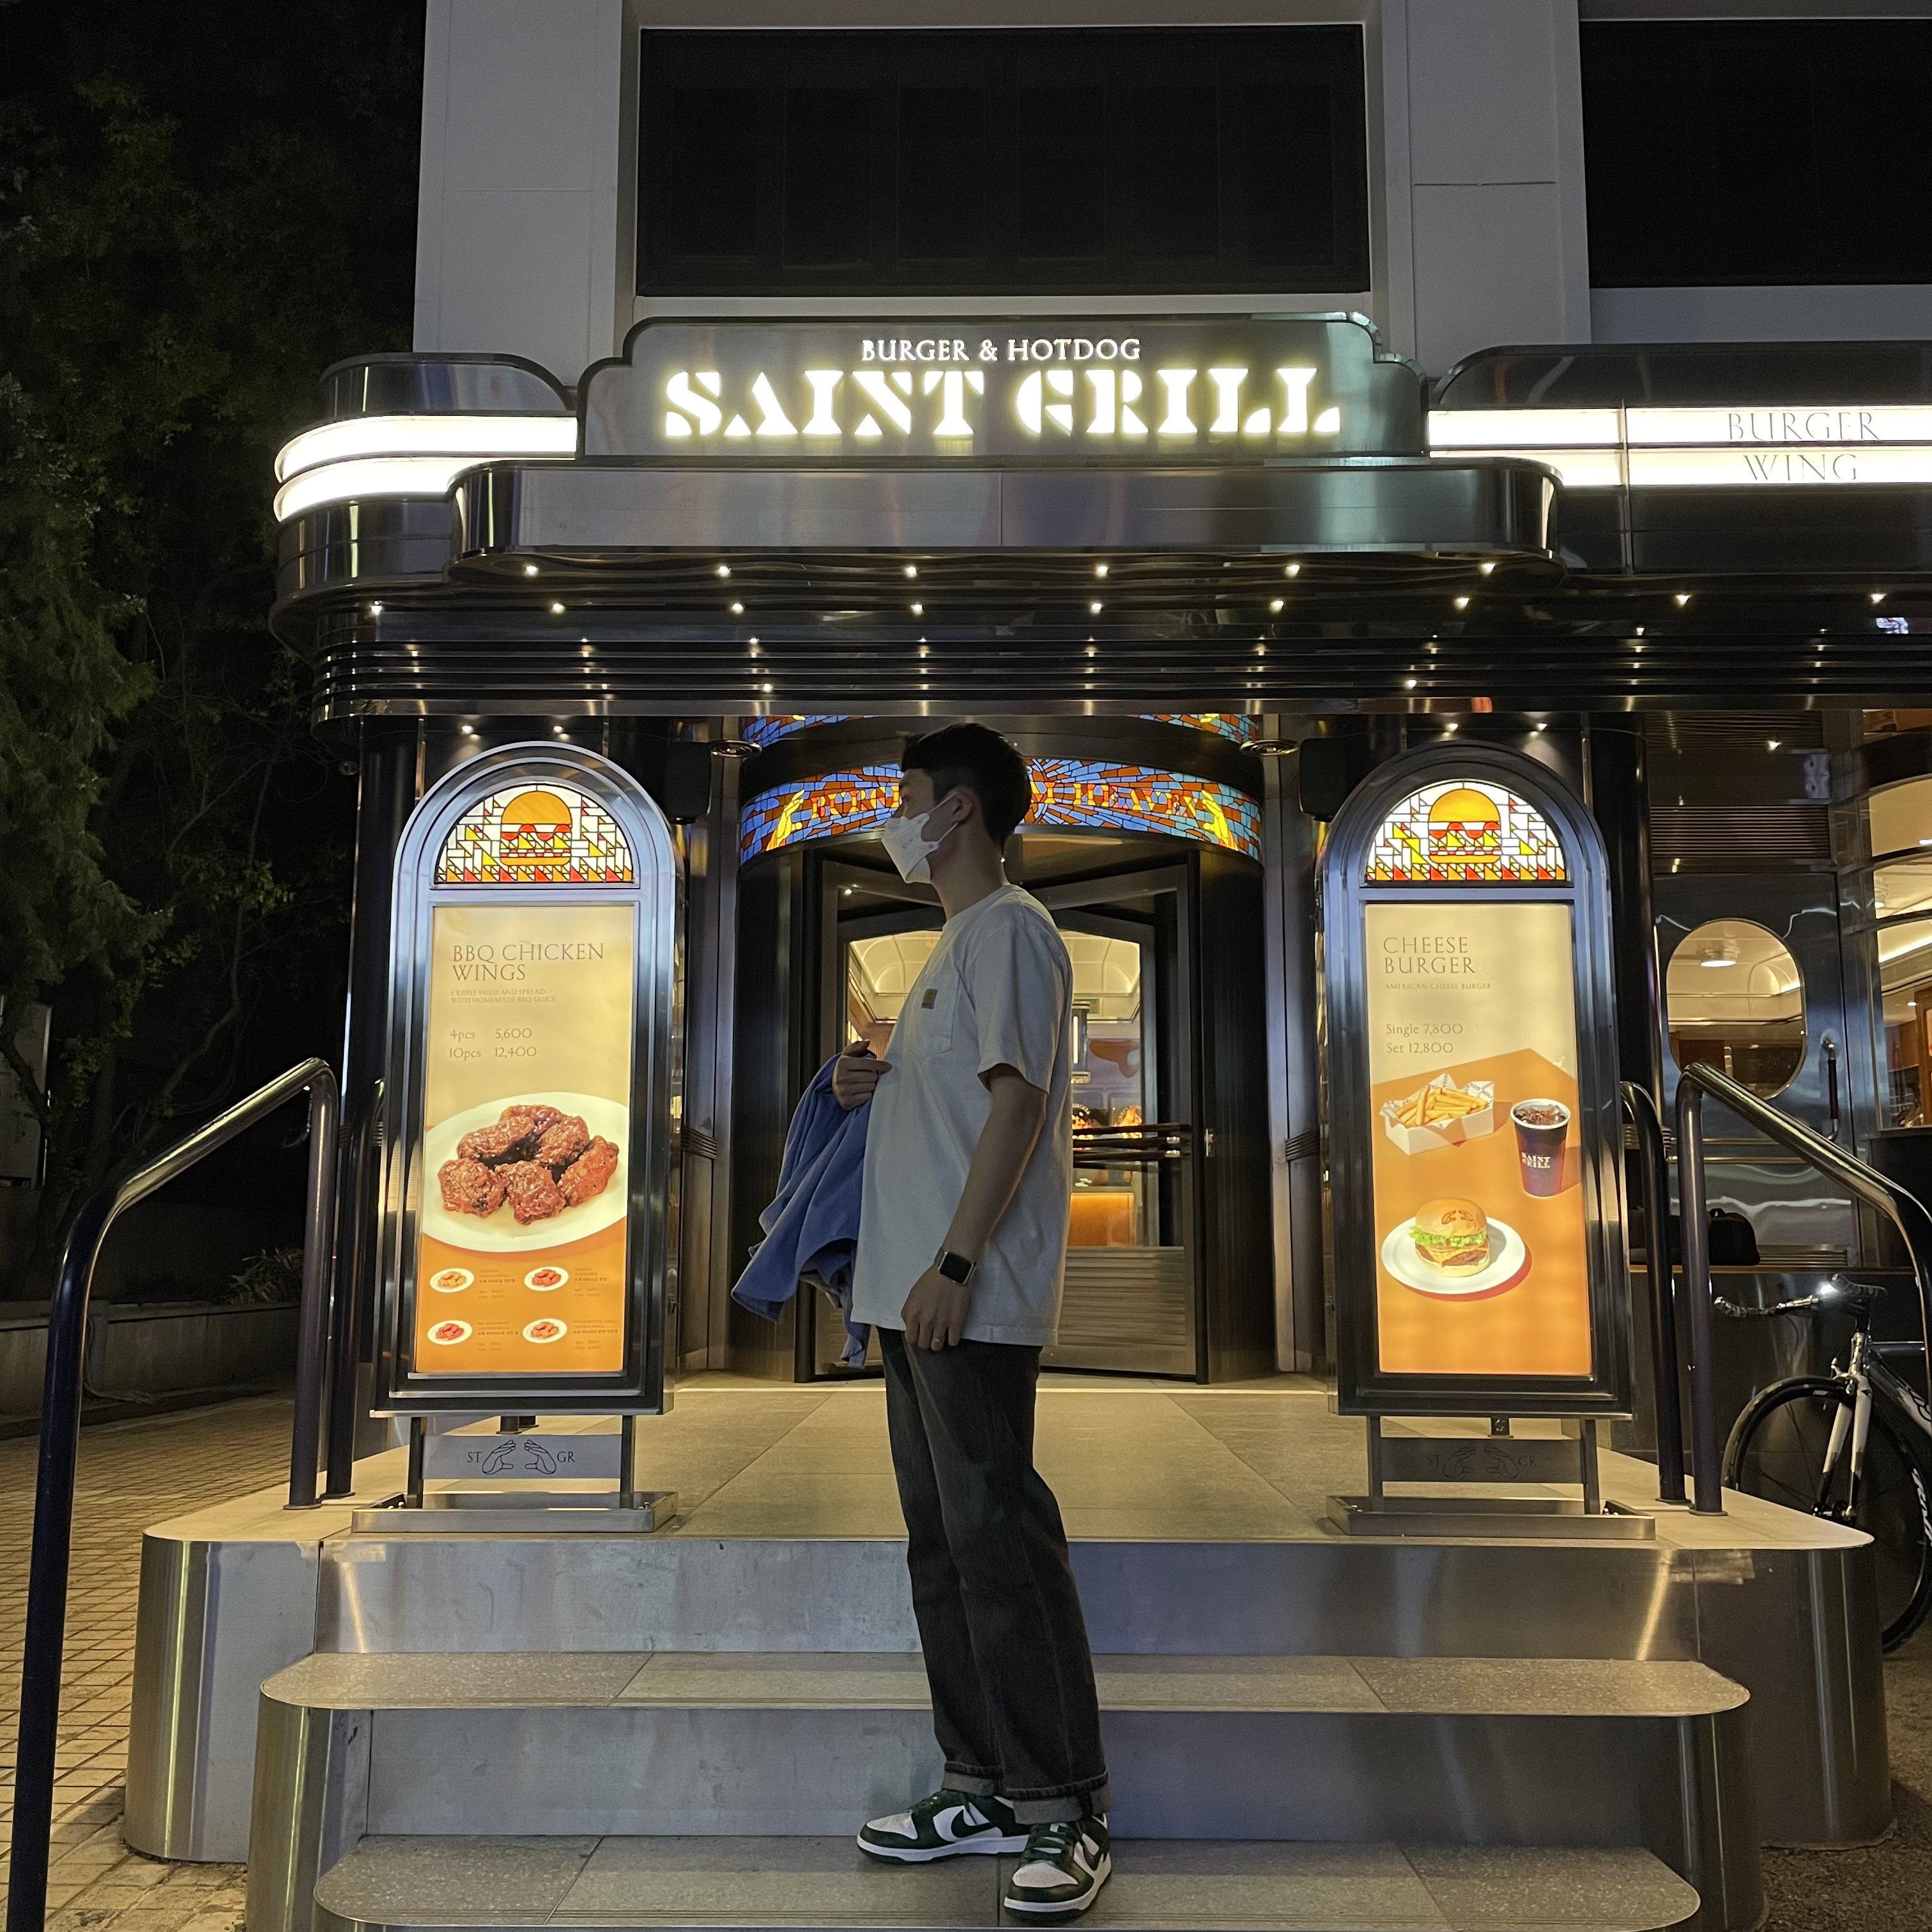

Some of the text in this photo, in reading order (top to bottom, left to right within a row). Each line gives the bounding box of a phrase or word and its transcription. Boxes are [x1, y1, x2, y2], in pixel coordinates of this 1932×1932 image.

[862, 339, 1140, 361] BURGER & HOTDOG
[665, 367, 1340, 436] SAINT GRILL
[1728, 412, 1881, 440] BURGER
[1743, 454, 1857, 481] WING
[1073, 782, 1197, 817] HEAVEN
[1384, 937, 1468, 953] CHEESE
[452, 943, 604, 965] BBQ CHICKEN
[452, 964, 525, 981] WINGS
[1385, 957, 1476, 974] BURGER
[450, 1028, 532, 1042] 4pcs 5,600
[1386, 1023, 1462, 1037] Single 7,800
[450, 1046, 537, 1061] 10pcs 12,400
[1386, 1043, 1453, 1054] Set 12,800
[1522, 1152, 1551, 1163] SAINT
[468, 1451, 574, 1463] ST GR
